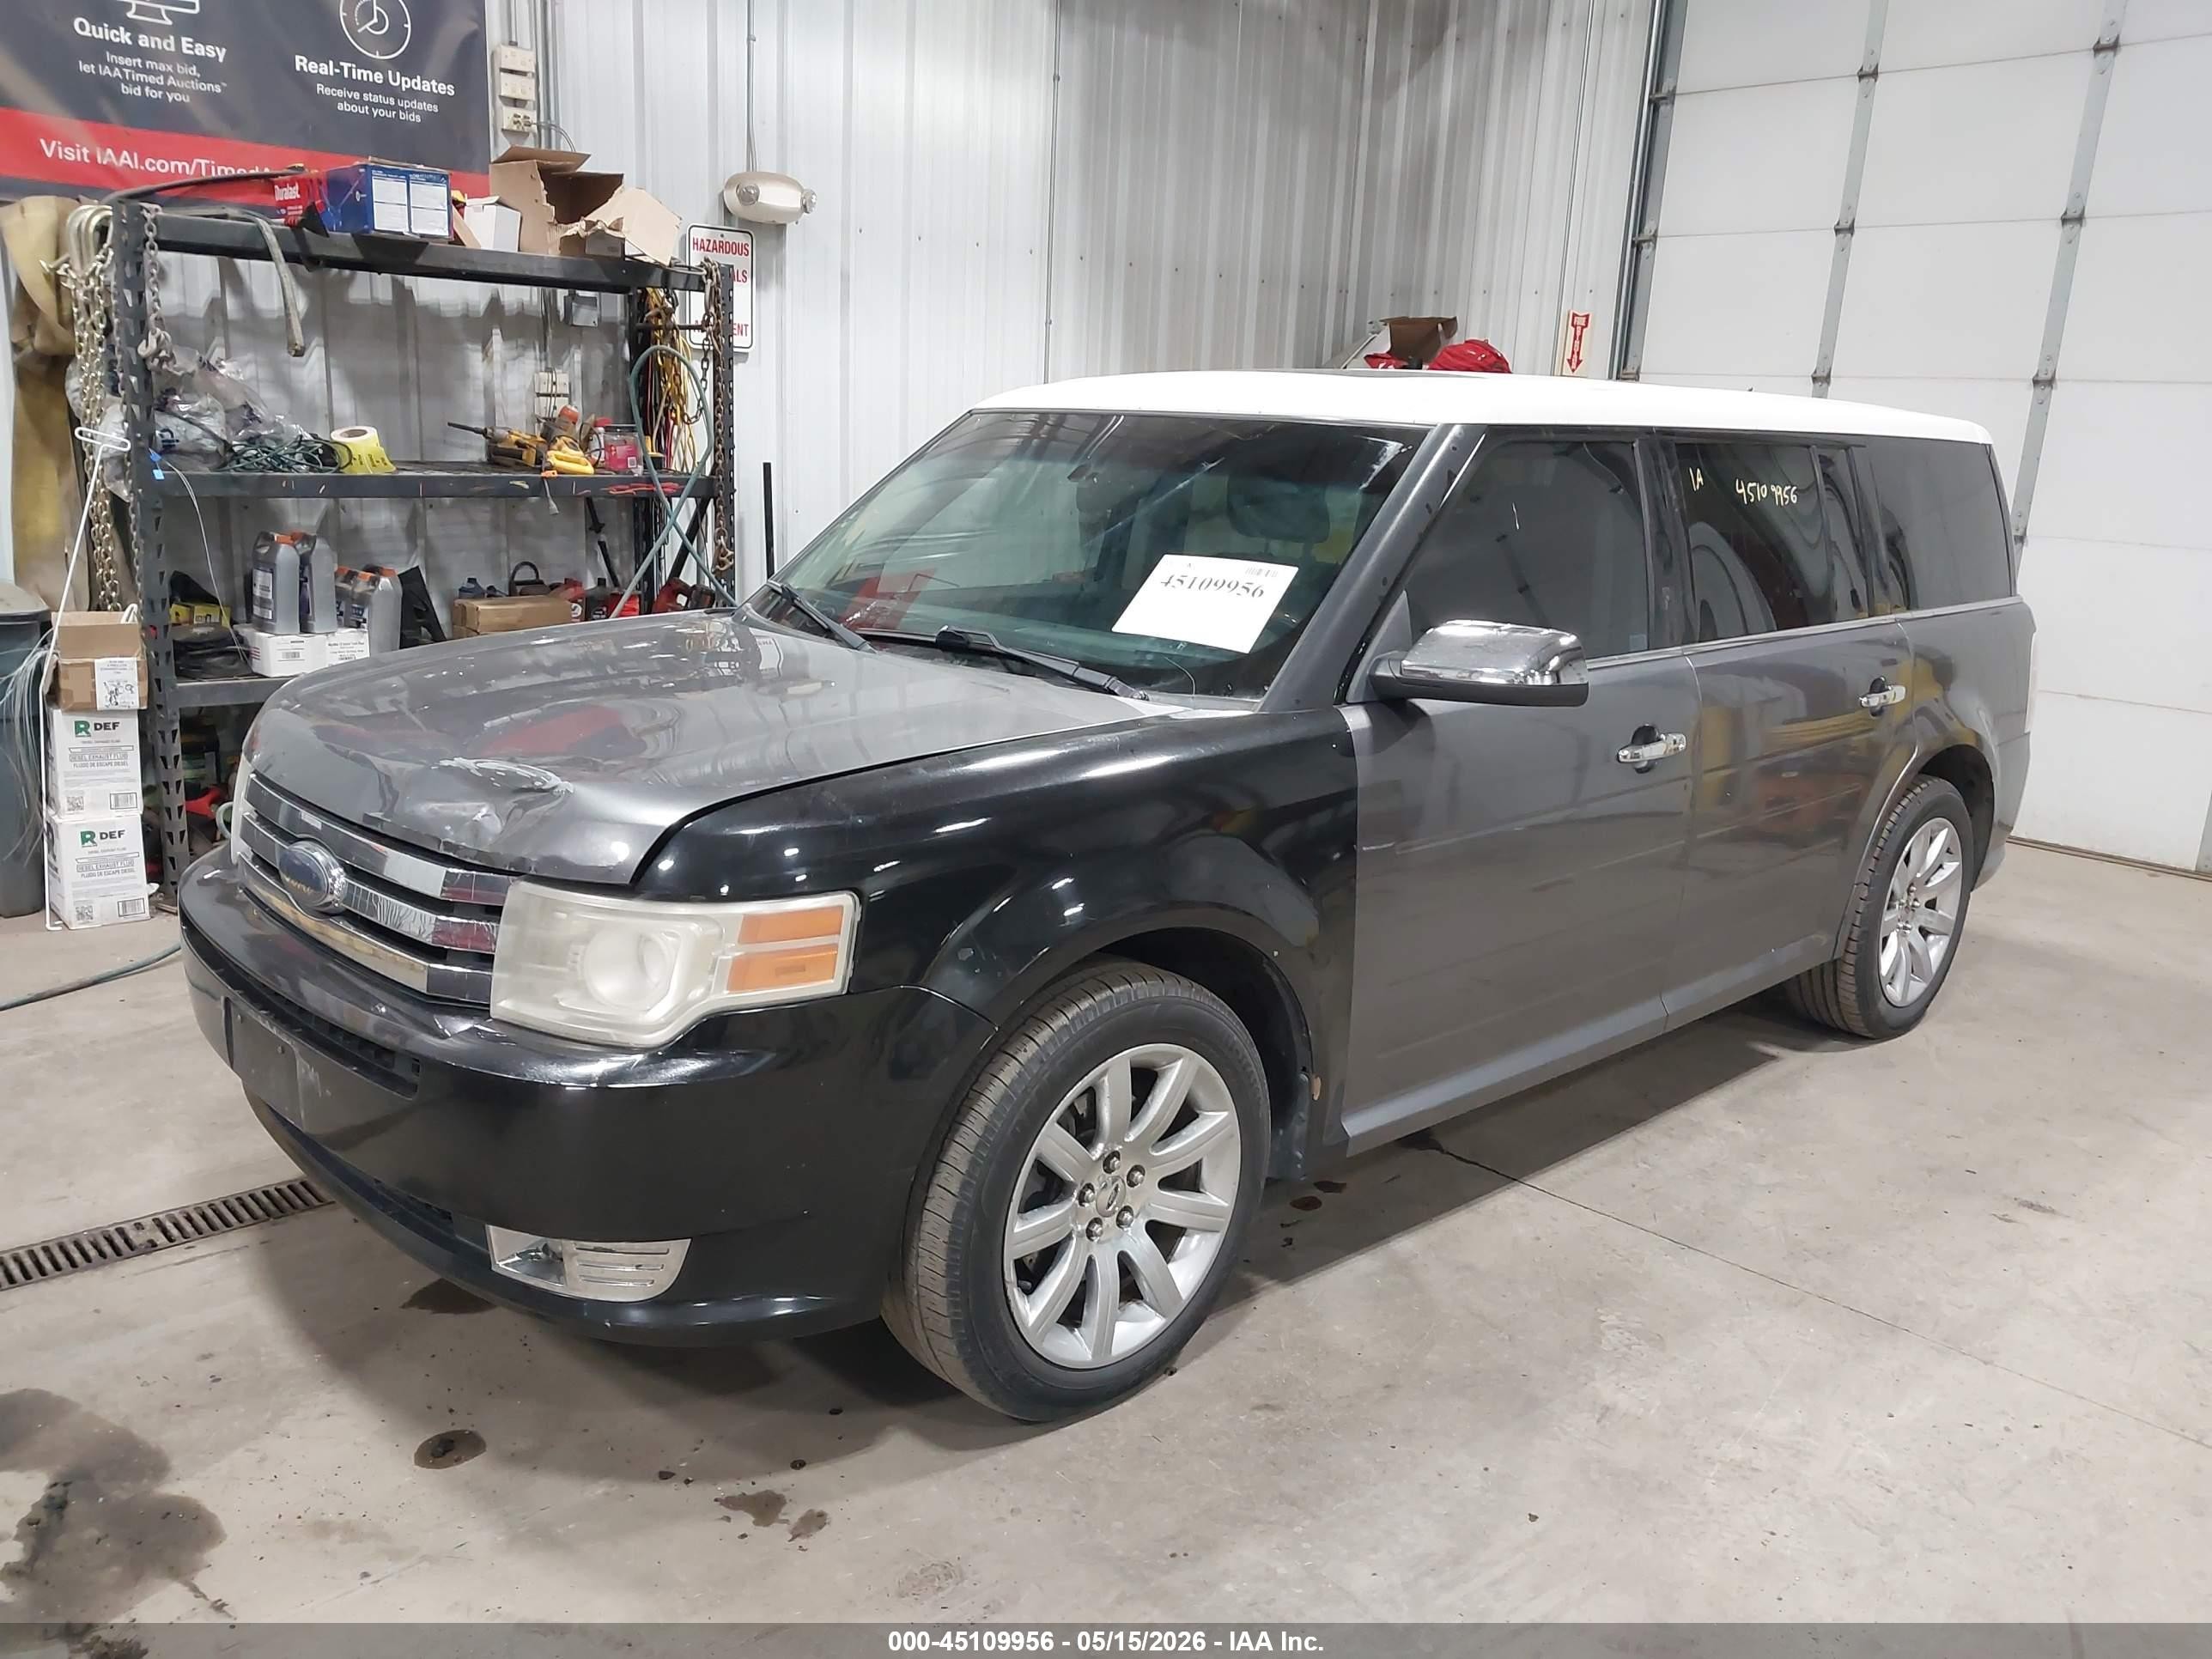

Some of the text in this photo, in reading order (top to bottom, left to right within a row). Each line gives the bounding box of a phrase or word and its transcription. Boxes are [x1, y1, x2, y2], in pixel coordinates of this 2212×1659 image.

[73, 17, 227, 63] Quick and Easy
[78, 60, 95, 75] let
[99, 64, 122, 79] IAA
[124, 70, 164, 86] Timed
[106, 52, 201, 78] Insert max bid,
[295, 55, 455, 96] Real-Time Updates
[121, 83, 191, 103] bid for you
[316, 83, 439, 112] Receive status updates
[337, 101, 422, 123] about your bids
[40, 138, 90, 164] Visit
[692, 237, 750, 257] HAZARDOUS
[1160, 574, 1265, 599] 45109956
[94, 721, 120, 732] DEF
[99, 830, 125, 841] DEF
